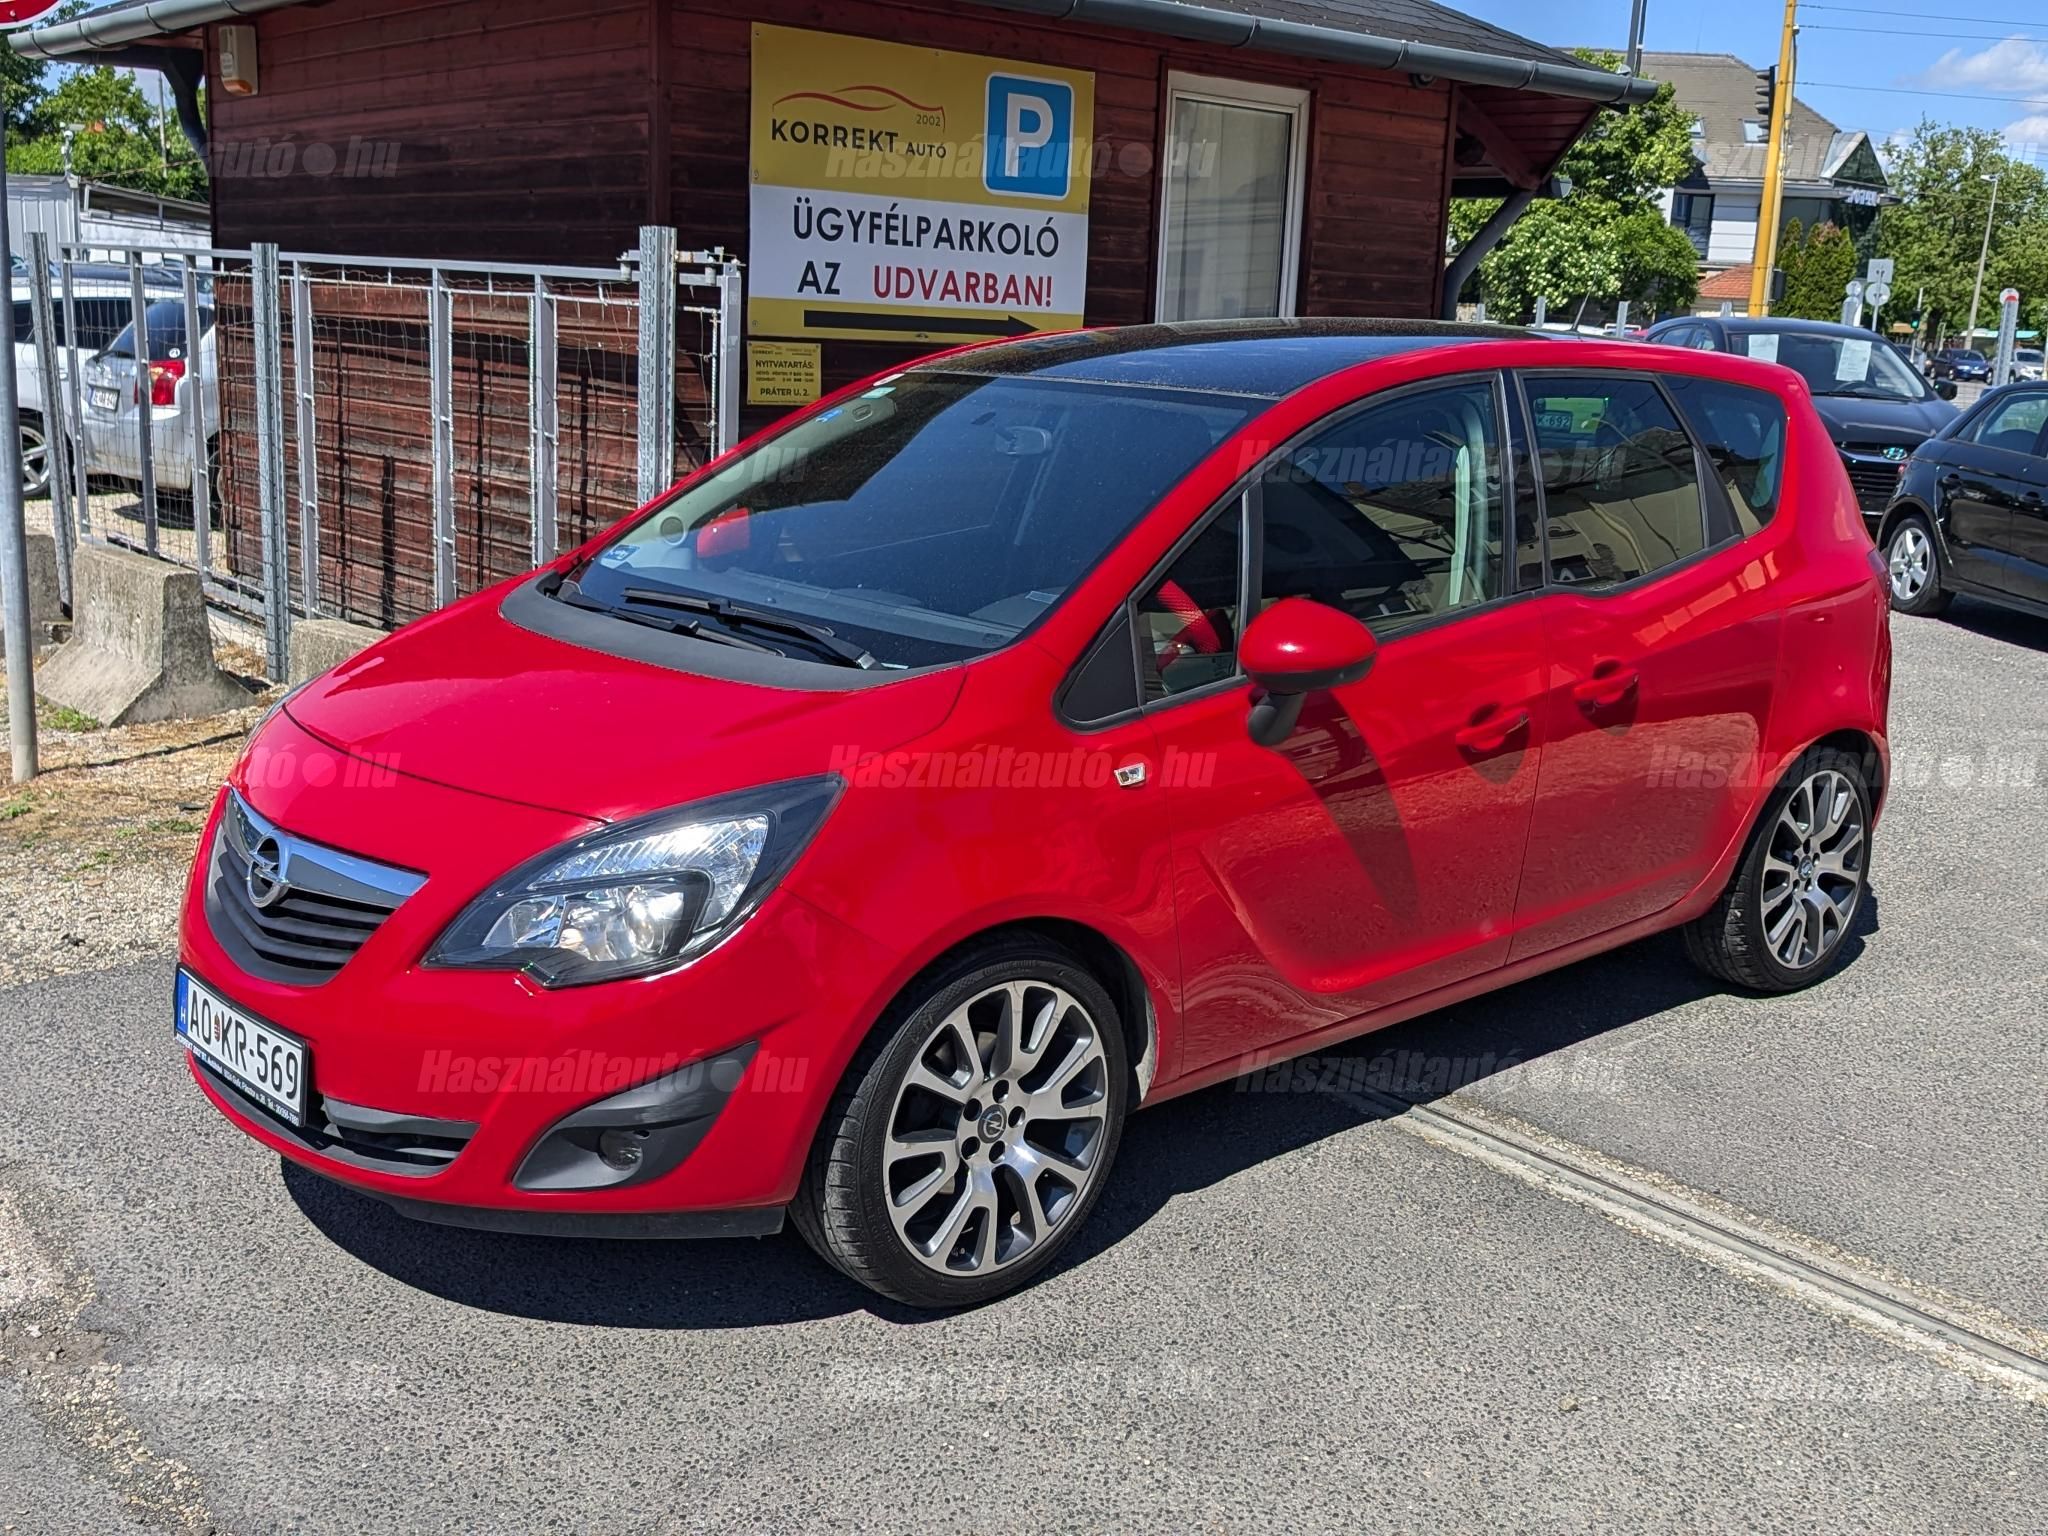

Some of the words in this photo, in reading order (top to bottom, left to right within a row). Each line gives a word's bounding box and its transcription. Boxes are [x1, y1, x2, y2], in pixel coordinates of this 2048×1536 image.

[772, 119, 898, 153] KORREKT
[905, 142, 947, 159] AUTÓ
[916, 114, 941, 127] 2002
[793, 196, 1059, 258] ÜGYFÉLPARKOLÓ
[797, 260, 841, 295] AZ
[873, 265, 1052, 308] UDVARBAN!
[760, 386, 792, 396] PRÁTER
[180, 1006, 187, 1025] H
[190, 989, 212, 1045] AO
[221, 1010, 299, 1100] KR-569
